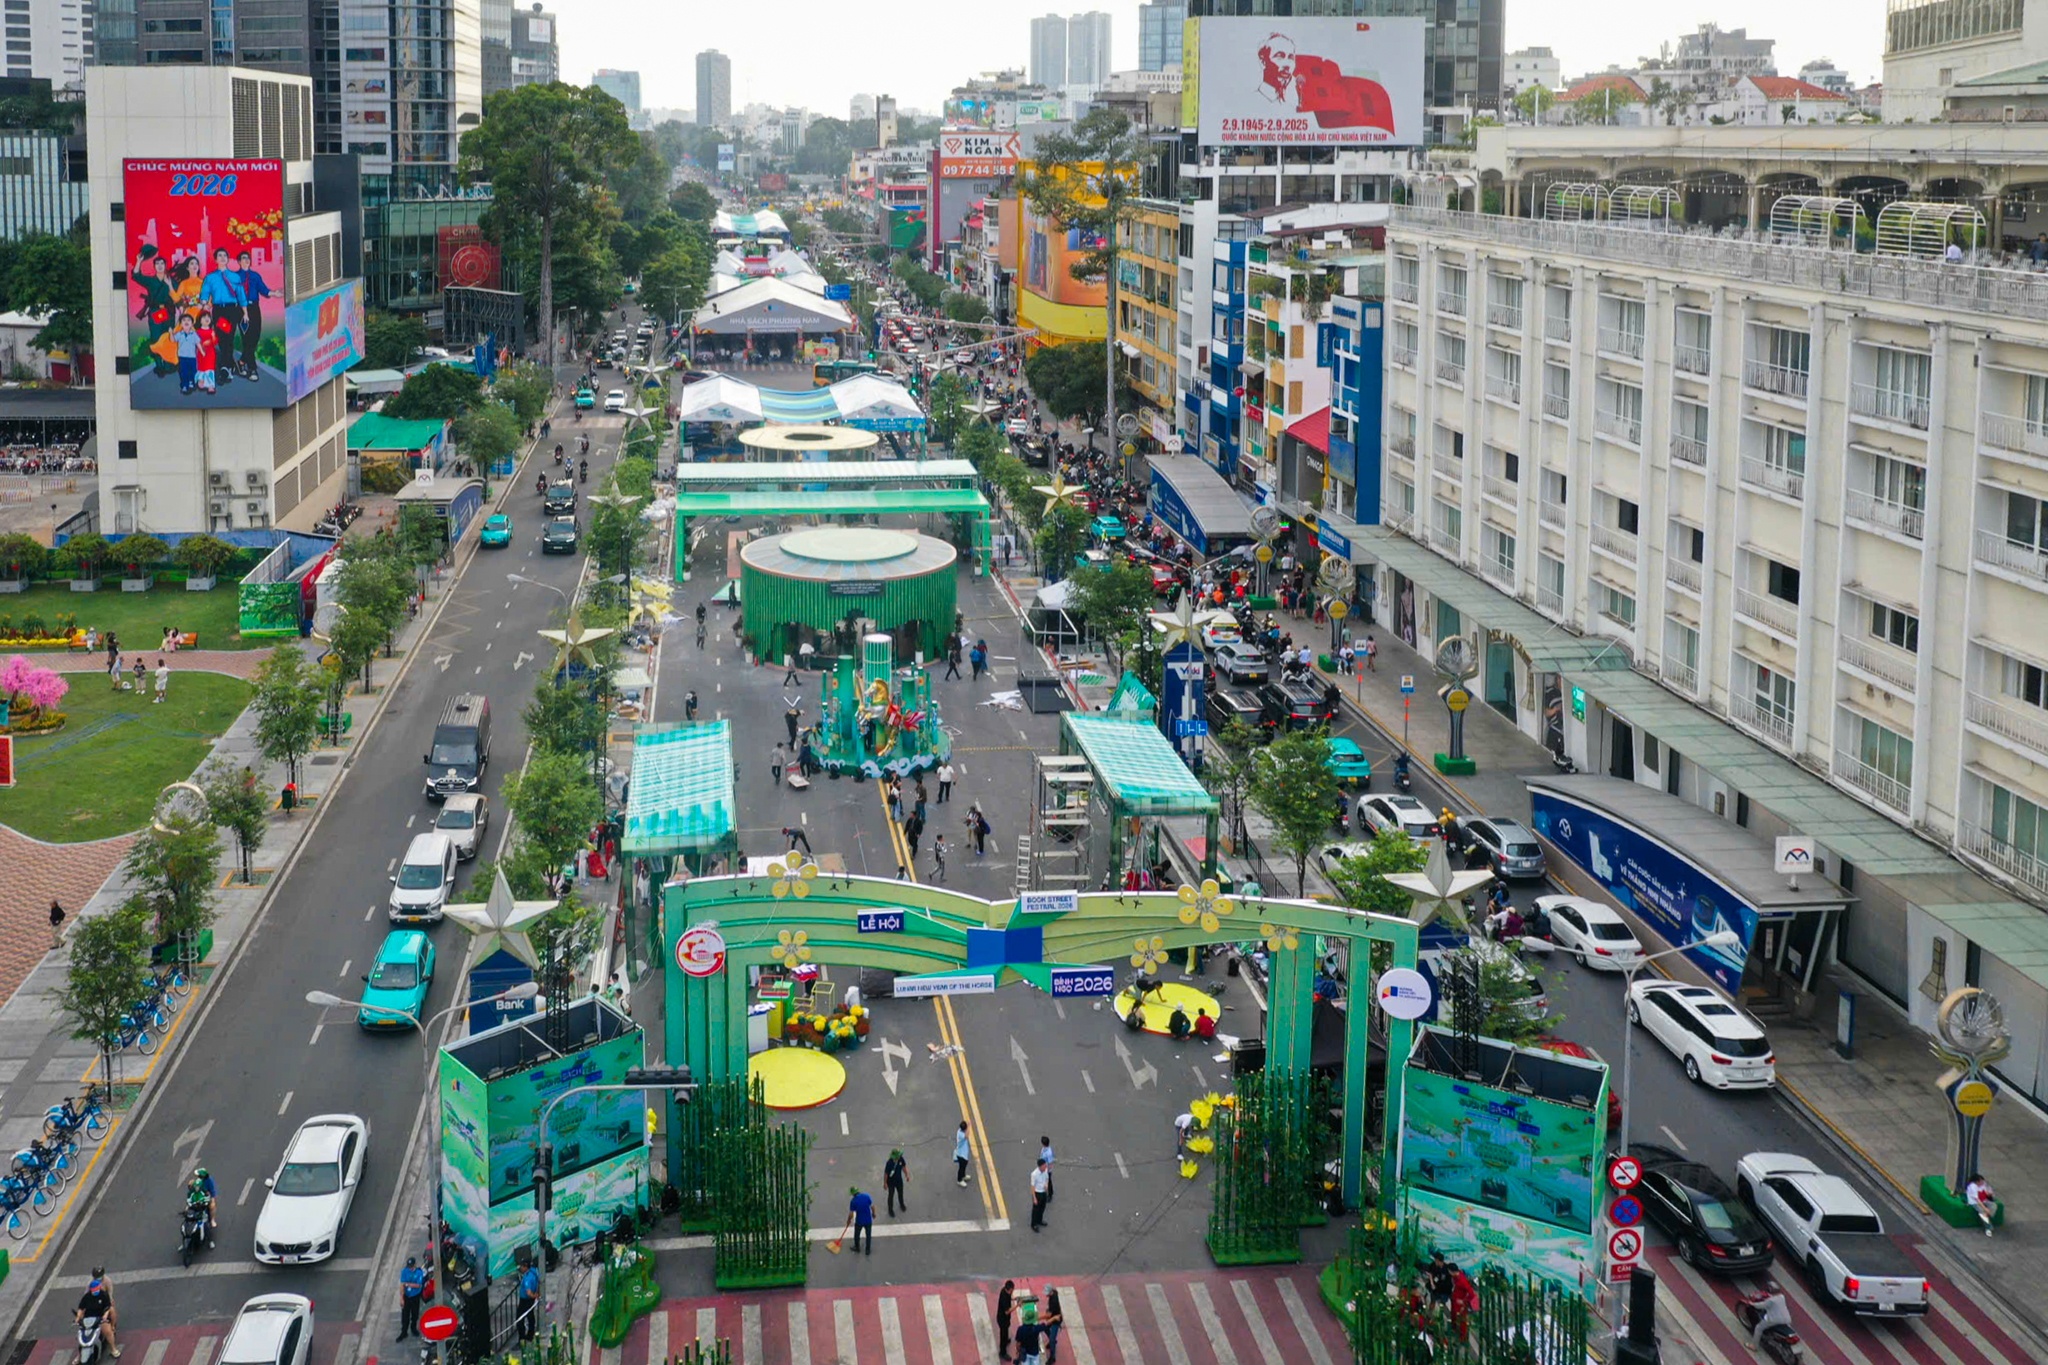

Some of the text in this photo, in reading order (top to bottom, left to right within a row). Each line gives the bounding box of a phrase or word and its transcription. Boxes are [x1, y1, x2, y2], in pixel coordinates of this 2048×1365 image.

[1222, 118, 1309, 131] 2.9.1945-2.9.2025
[965, 137, 989, 146] KIM
[1373, 133, 1388, 141] NAM
[965, 146, 1002, 155] NGAN
[127, 161, 167, 171] CHÚC
[169, 162, 212, 171] MỪNG
[250, 160, 278, 171] MỚI
[169, 173, 238, 196] 2026
[729, 316, 746, 325] NHÀ
[747, 316, 768, 325] SÁCH
[769, 317, 801, 325] PHƯƠNG
[860, 914, 900, 930] LỄ HỘI
[1074, 976, 1113, 992] 2026
[496, 999, 525, 1010] Bank
